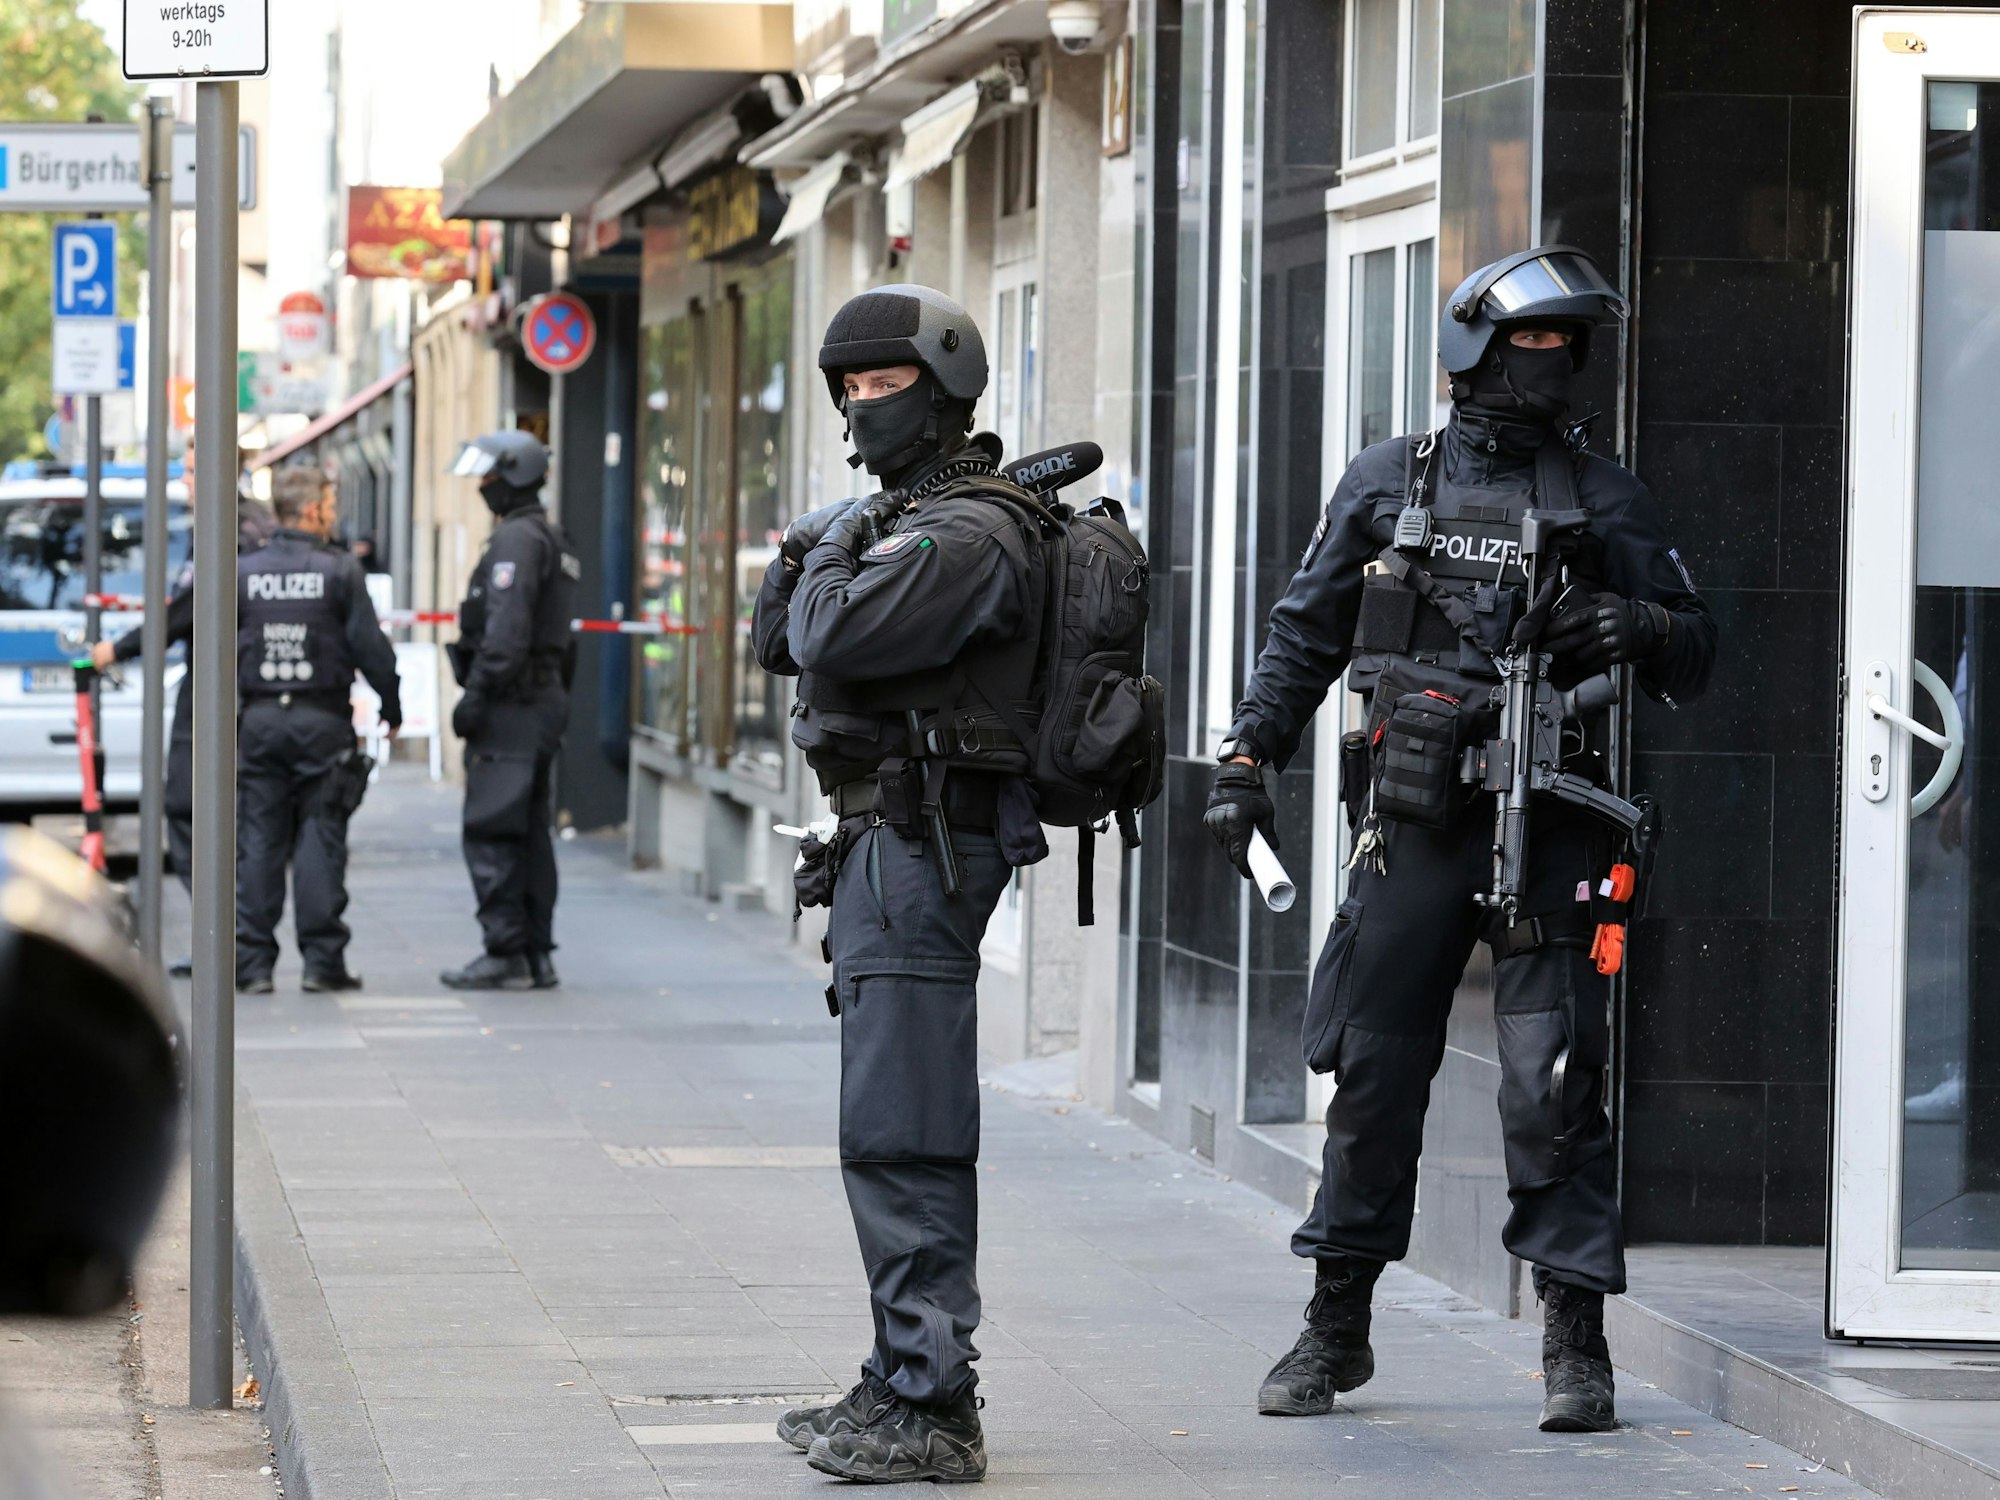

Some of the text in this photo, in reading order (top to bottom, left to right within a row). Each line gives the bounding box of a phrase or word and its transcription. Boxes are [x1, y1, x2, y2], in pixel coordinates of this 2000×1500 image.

[160, 2, 225, 23] werktags
[172, 29, 212, 48] 9-20h
[19, 152, 141, 191] Bürgerha
[62, 233, 99, 309] P
[1015, 451, 1077, 487] RØDE
[247, 573, 324, 600] POLIZEI
[263, 622, 307, 641] NRW
